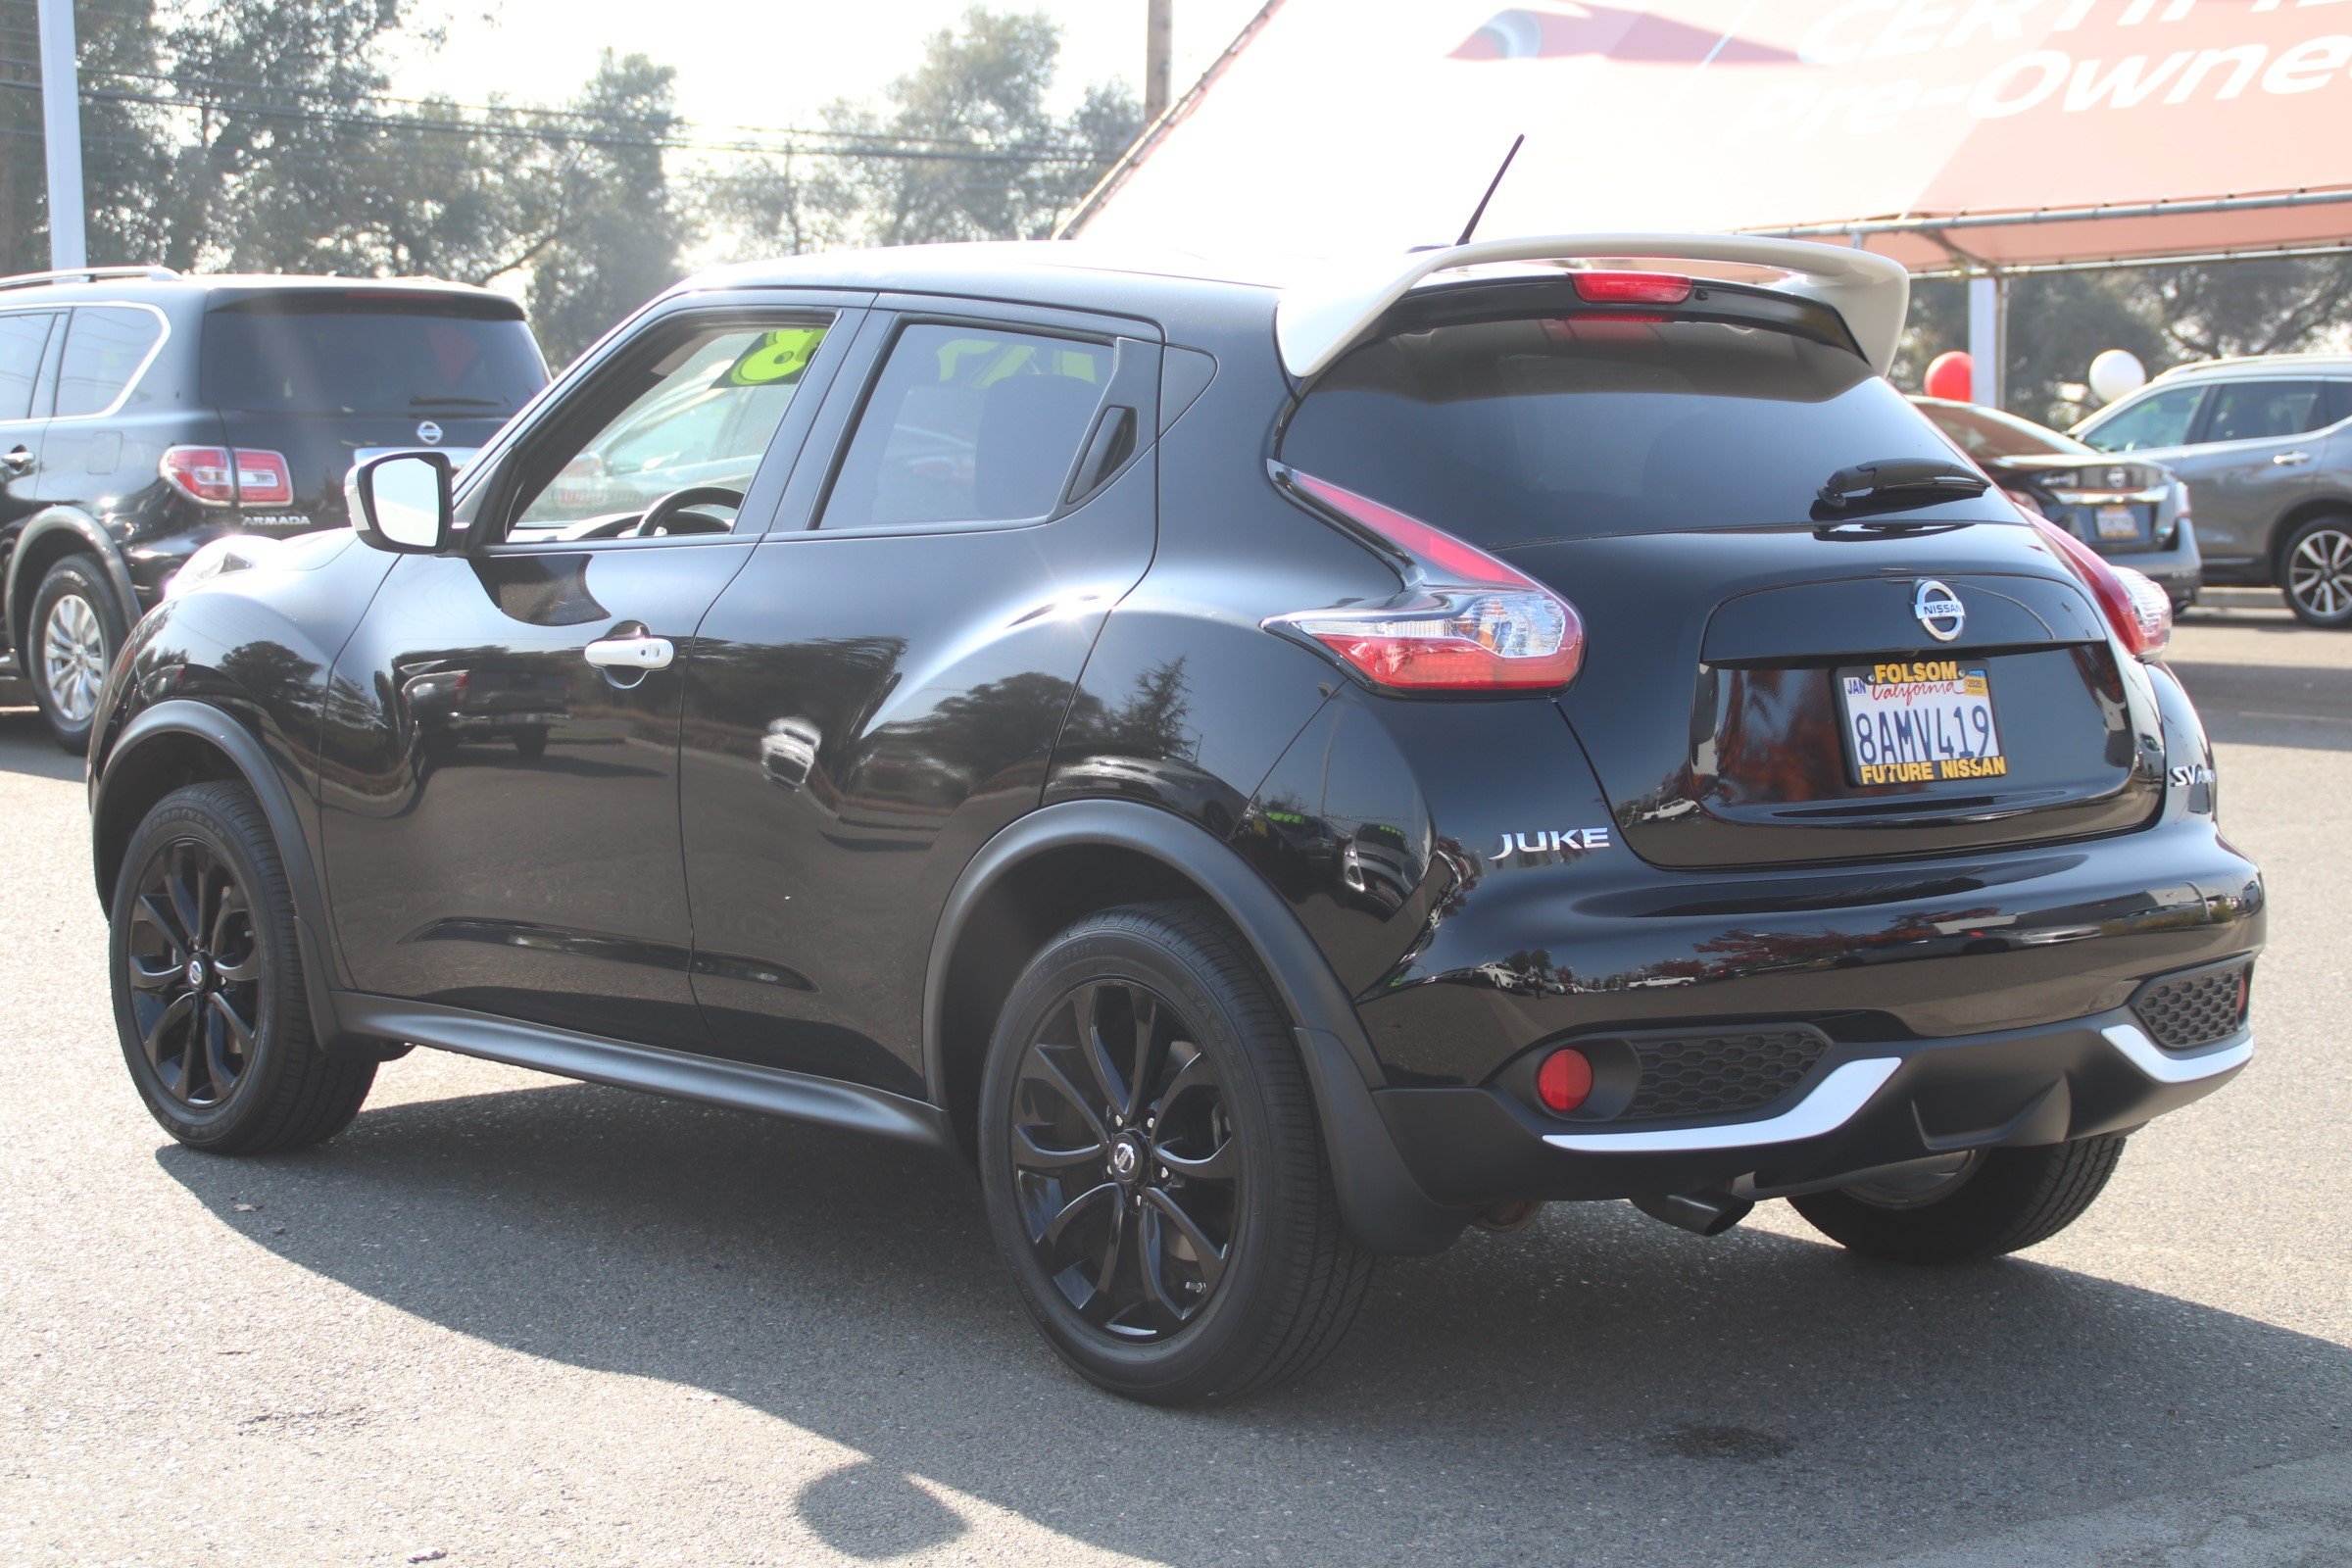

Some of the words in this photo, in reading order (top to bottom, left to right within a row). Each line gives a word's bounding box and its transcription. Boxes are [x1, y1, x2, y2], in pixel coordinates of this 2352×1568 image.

[1724, 33, 2352, 147] Pre-Owne
[241, 515, 312, 526] ARMADA
[1923, 604, 1962, 615] NISSAN
[1874, 661, 1958, 684] FOLSOM
[1846, 679, 1867, 695] JAN
[1872, 681, 1965, 707] California
[1855, 705, 1989, 765] 8AMV419
[1860, 762, 1935, 784] FUTURE
[1941, 756, 2006, 779] NISSAN
[1488, 827, 1610, 861] JUKE
